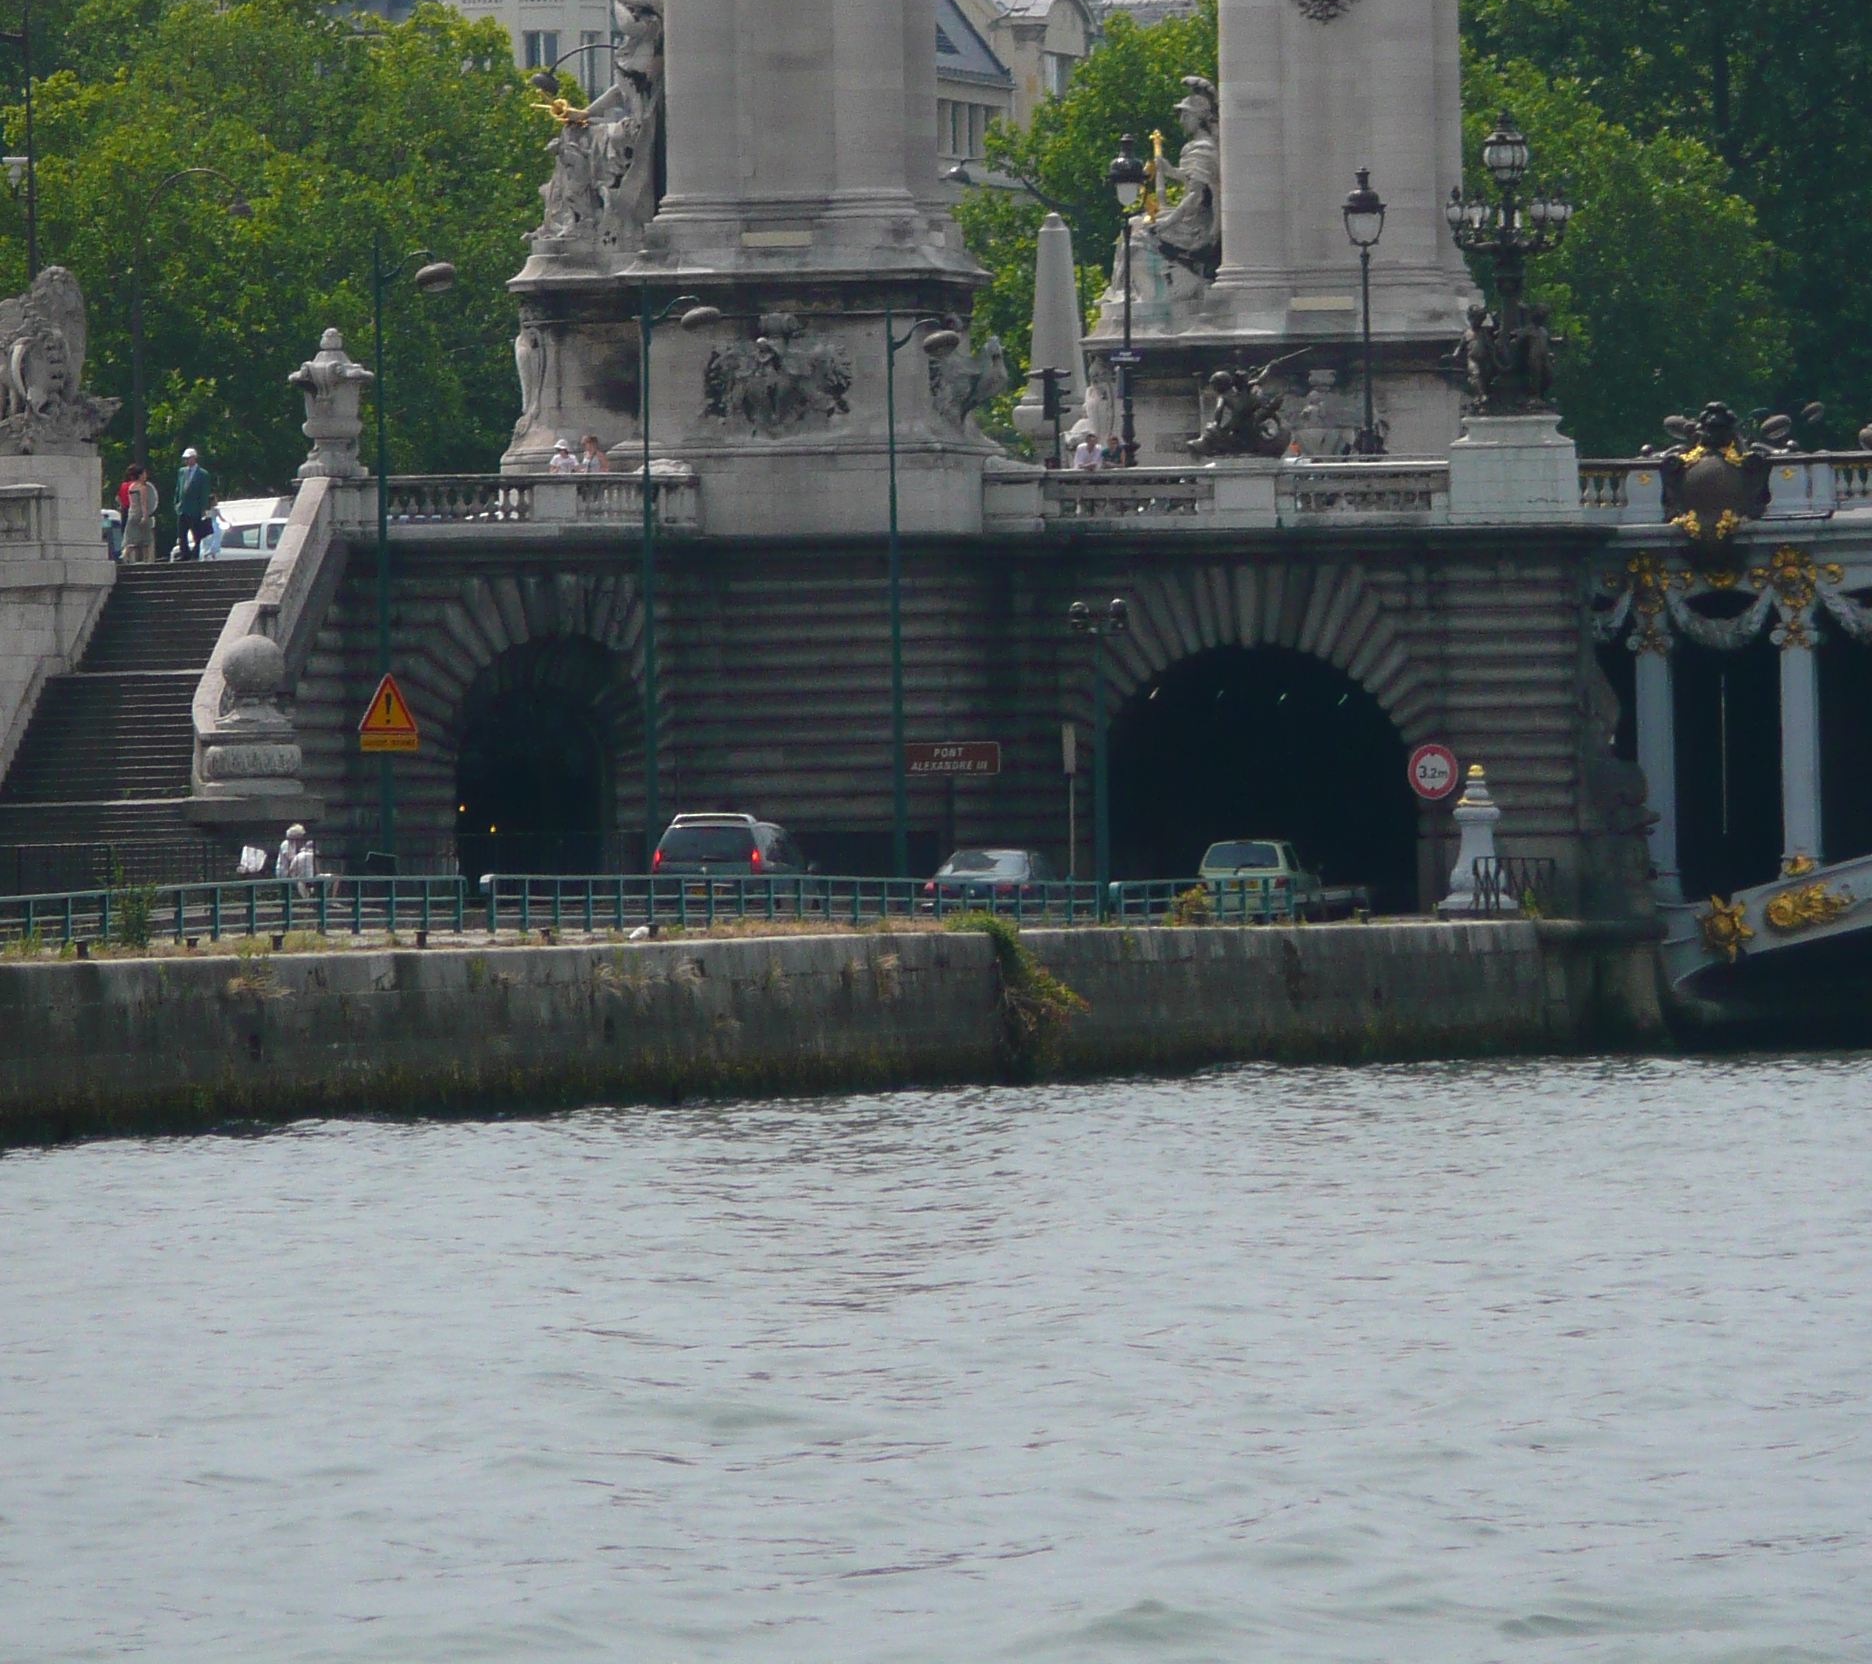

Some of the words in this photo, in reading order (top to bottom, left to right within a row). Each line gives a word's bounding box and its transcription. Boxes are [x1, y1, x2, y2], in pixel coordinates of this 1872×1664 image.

[934, 747, 964, 757] PONT
[911, 760, 972, 770] ALEXANDRE
[976, 760, 988, 770] III
